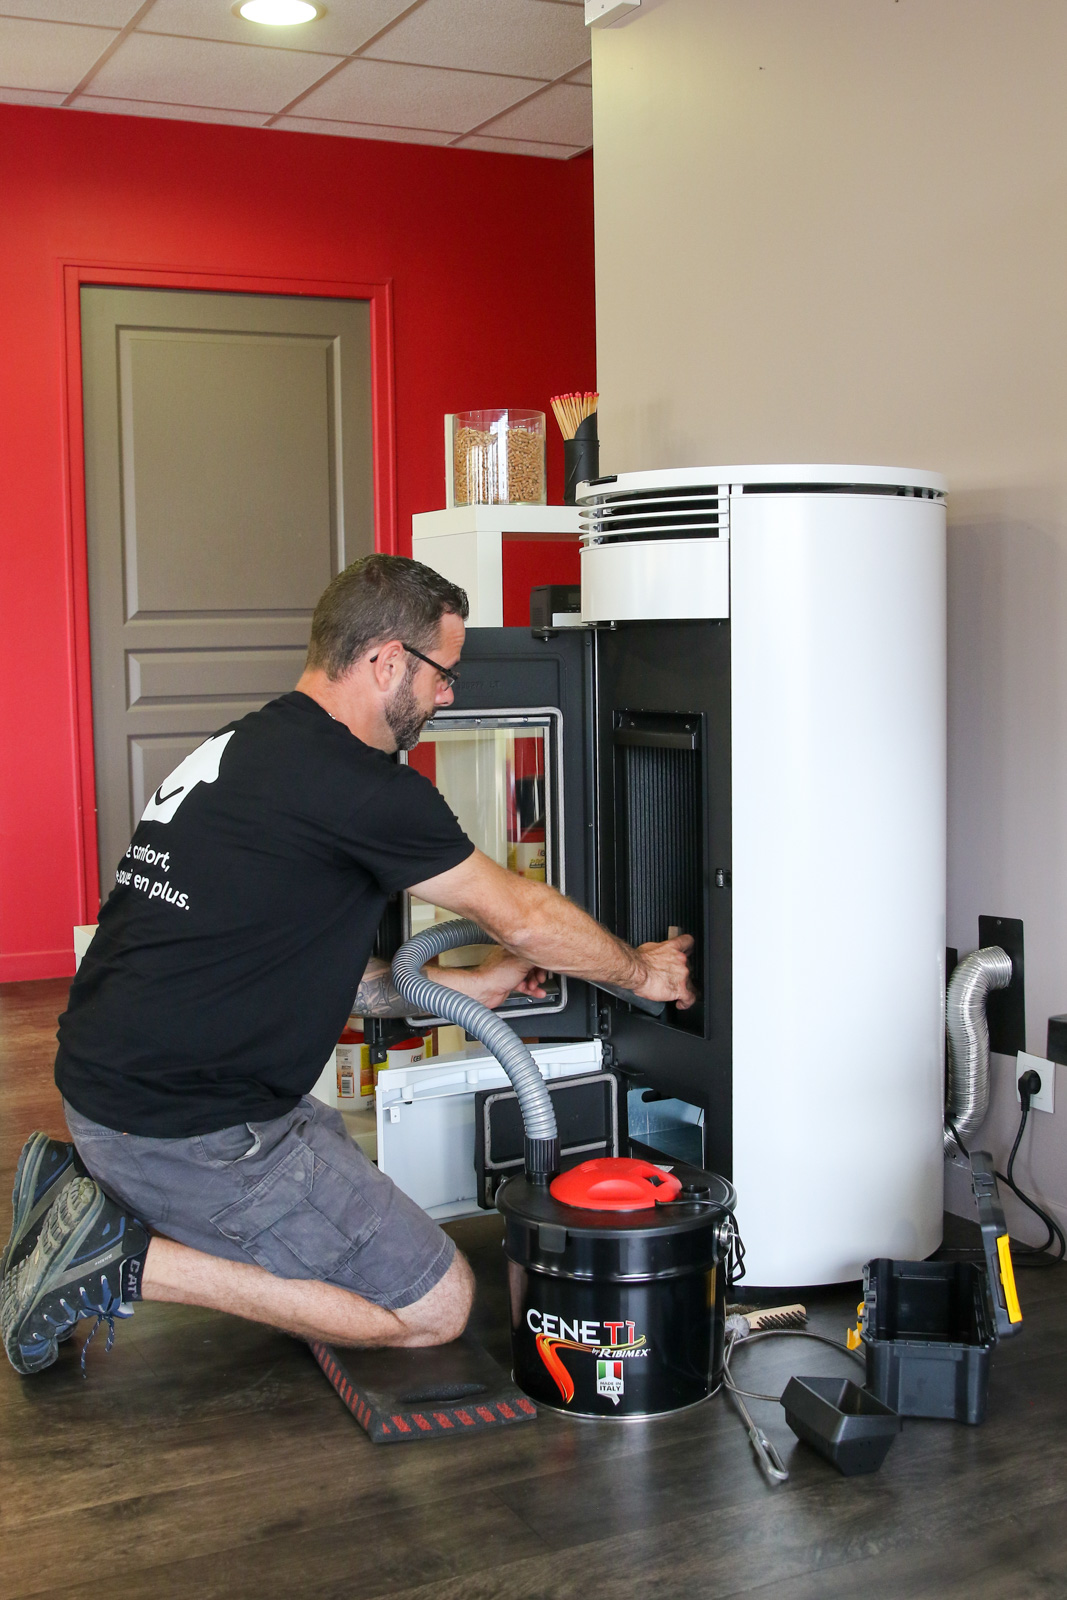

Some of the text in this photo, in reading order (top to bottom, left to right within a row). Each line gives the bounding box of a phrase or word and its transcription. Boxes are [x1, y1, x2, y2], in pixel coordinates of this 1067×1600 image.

[134, 874, 149, 892] en
[148, 881, 190, 911] plus.
[127, 1259, 140, 1292] CAT
